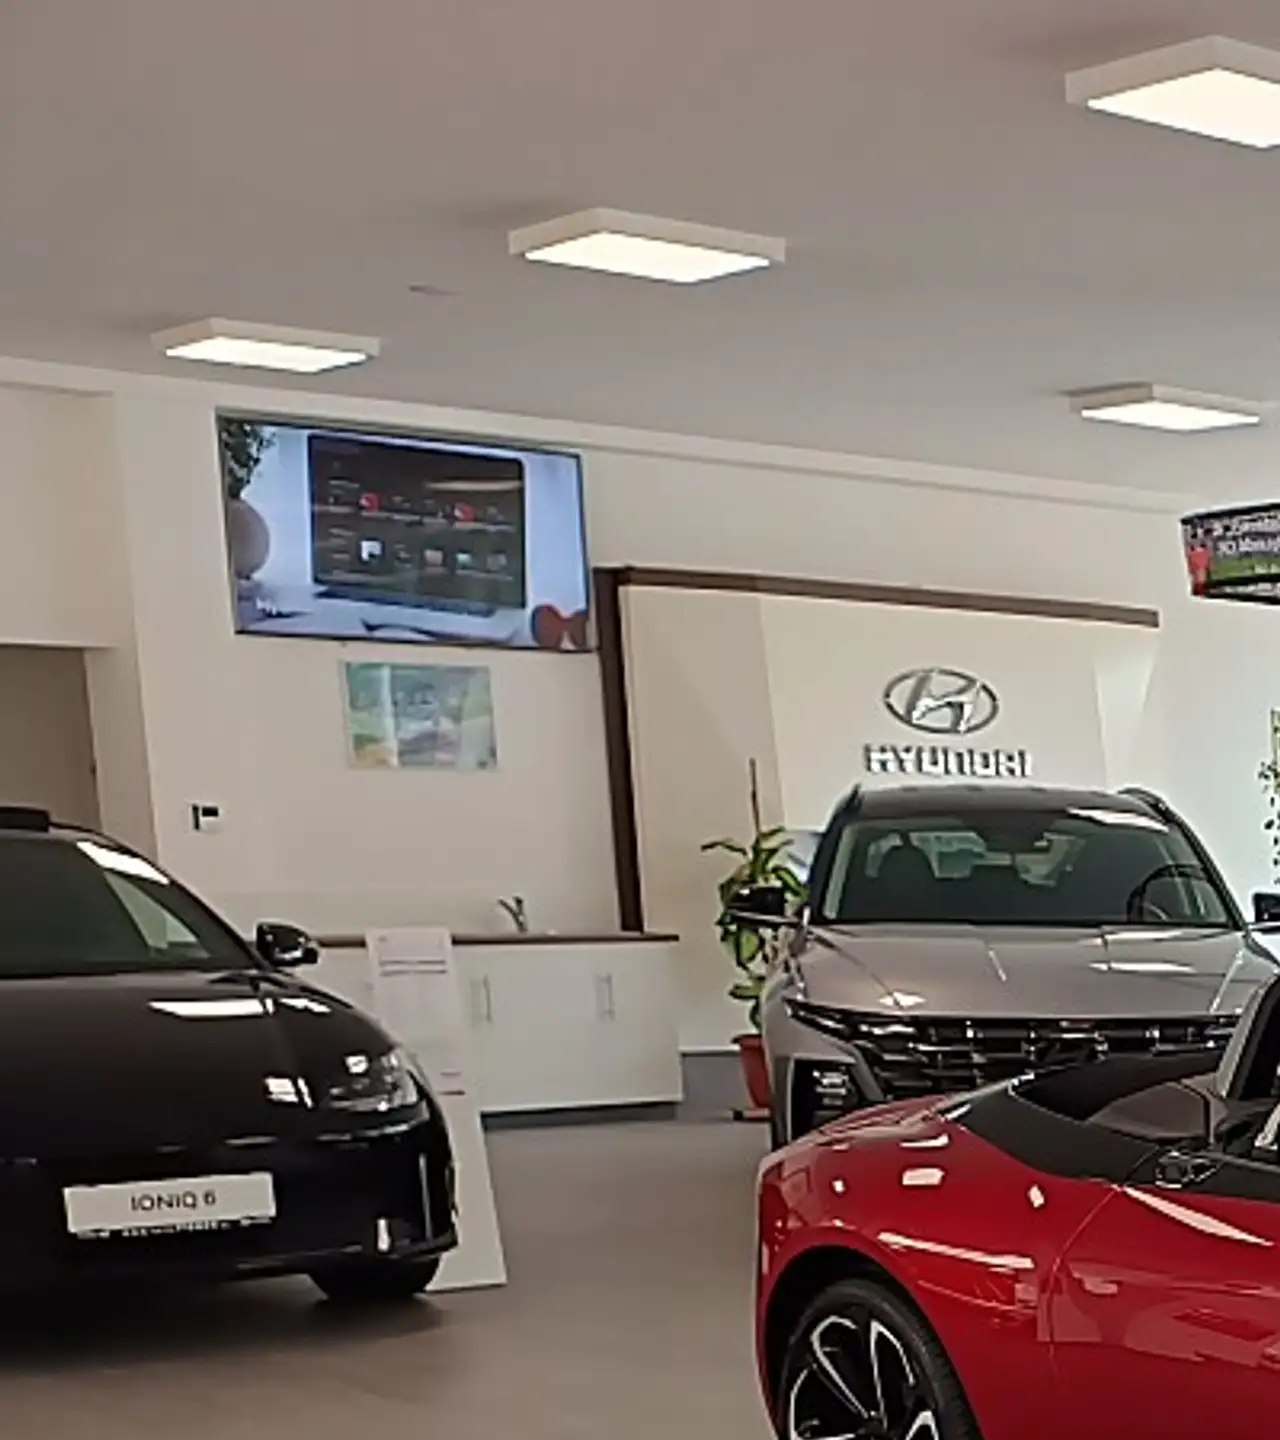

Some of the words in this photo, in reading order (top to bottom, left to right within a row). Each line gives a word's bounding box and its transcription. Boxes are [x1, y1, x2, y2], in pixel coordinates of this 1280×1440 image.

[863, 743, 1032, 778] HYUNDAI
[129, 1191, 198, 1212] IONIQ
[203, 1189, 217, 1206] 6
